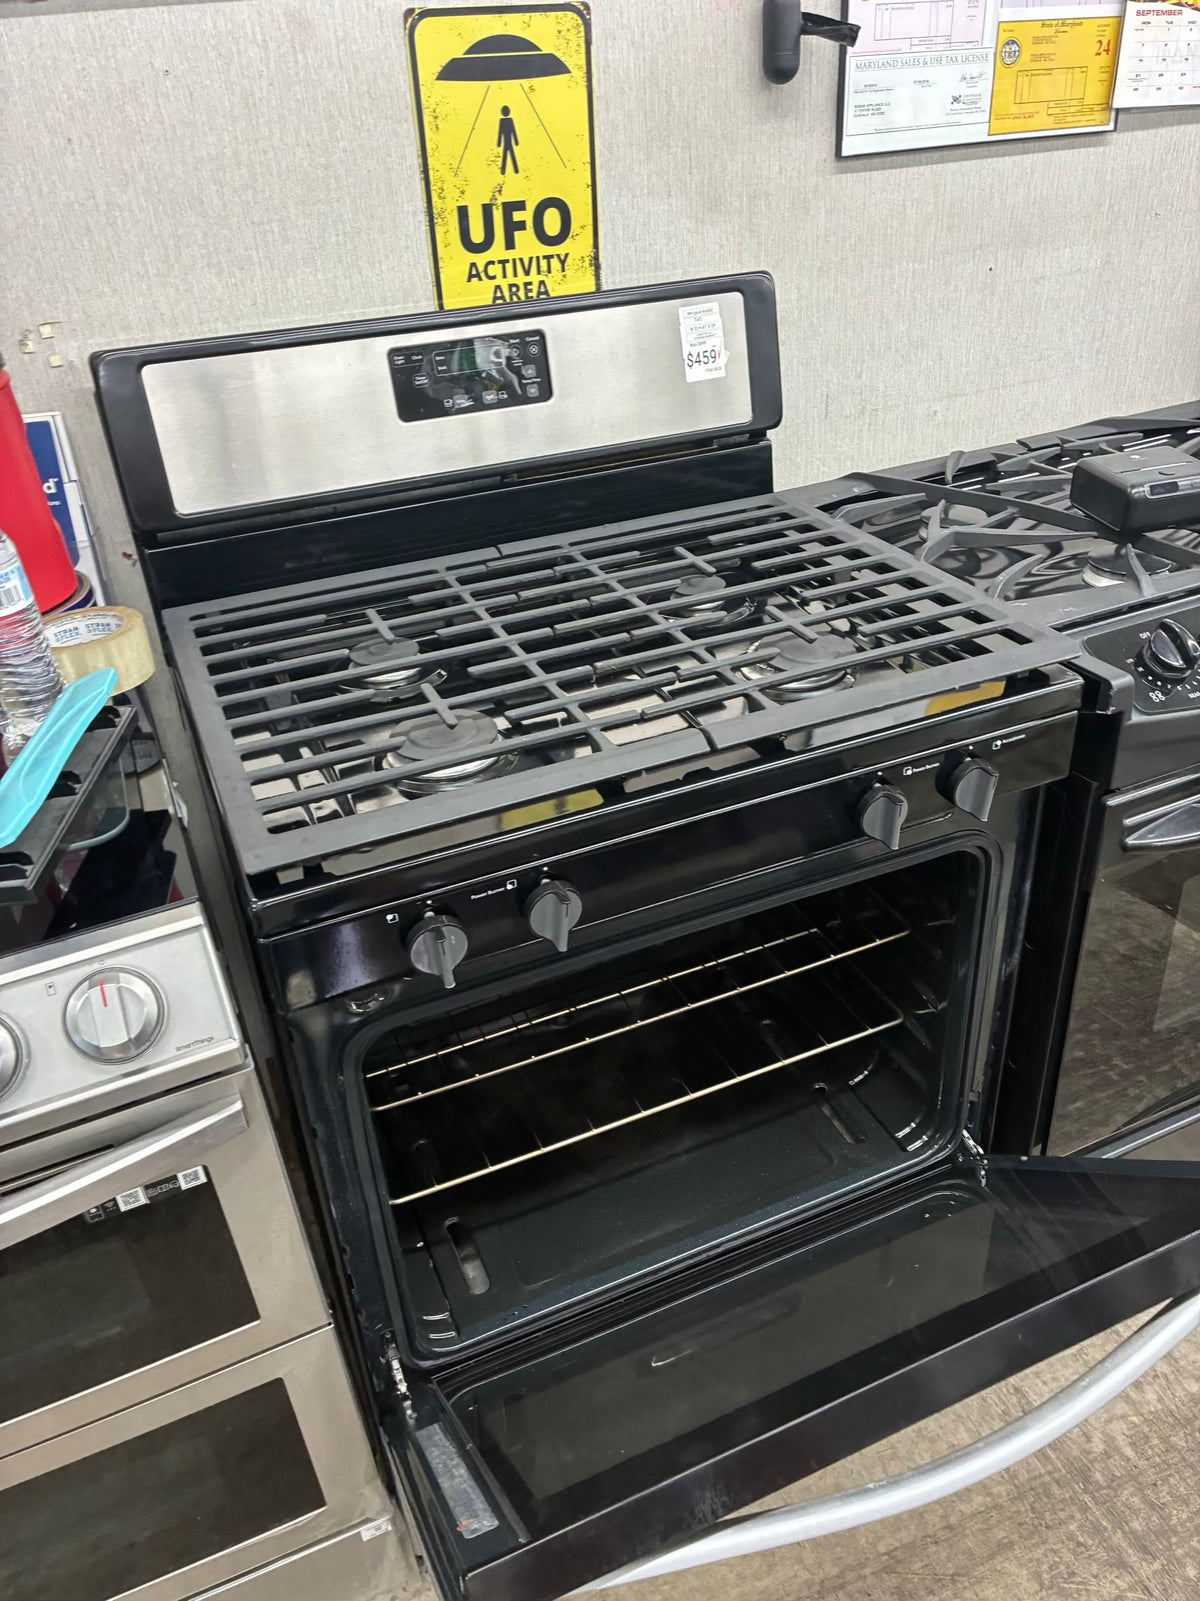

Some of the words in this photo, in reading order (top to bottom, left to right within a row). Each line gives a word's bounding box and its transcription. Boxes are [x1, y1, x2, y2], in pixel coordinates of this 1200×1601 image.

[1135, 9, 1183, 17] SEPTEMBER
[1094, 39, 1111, 56] 24
[854, 59, 899, 71] MARYLAND
[900, 57, 921, 68] SALES
[922, 57, 928, 66] &
[930, 56, 943, 65] USE
[945, 55, 959, 64] TAX
[960, 53, 989, 63] LICENSE
[456, 197, 572, 254] UFO
[466, 252, 570, 283] ACTIVITY
[491, 279, 551, 304] AREA
[687, 349, 717, 369] $459
[1139, 631, 1151, 639] OFF
